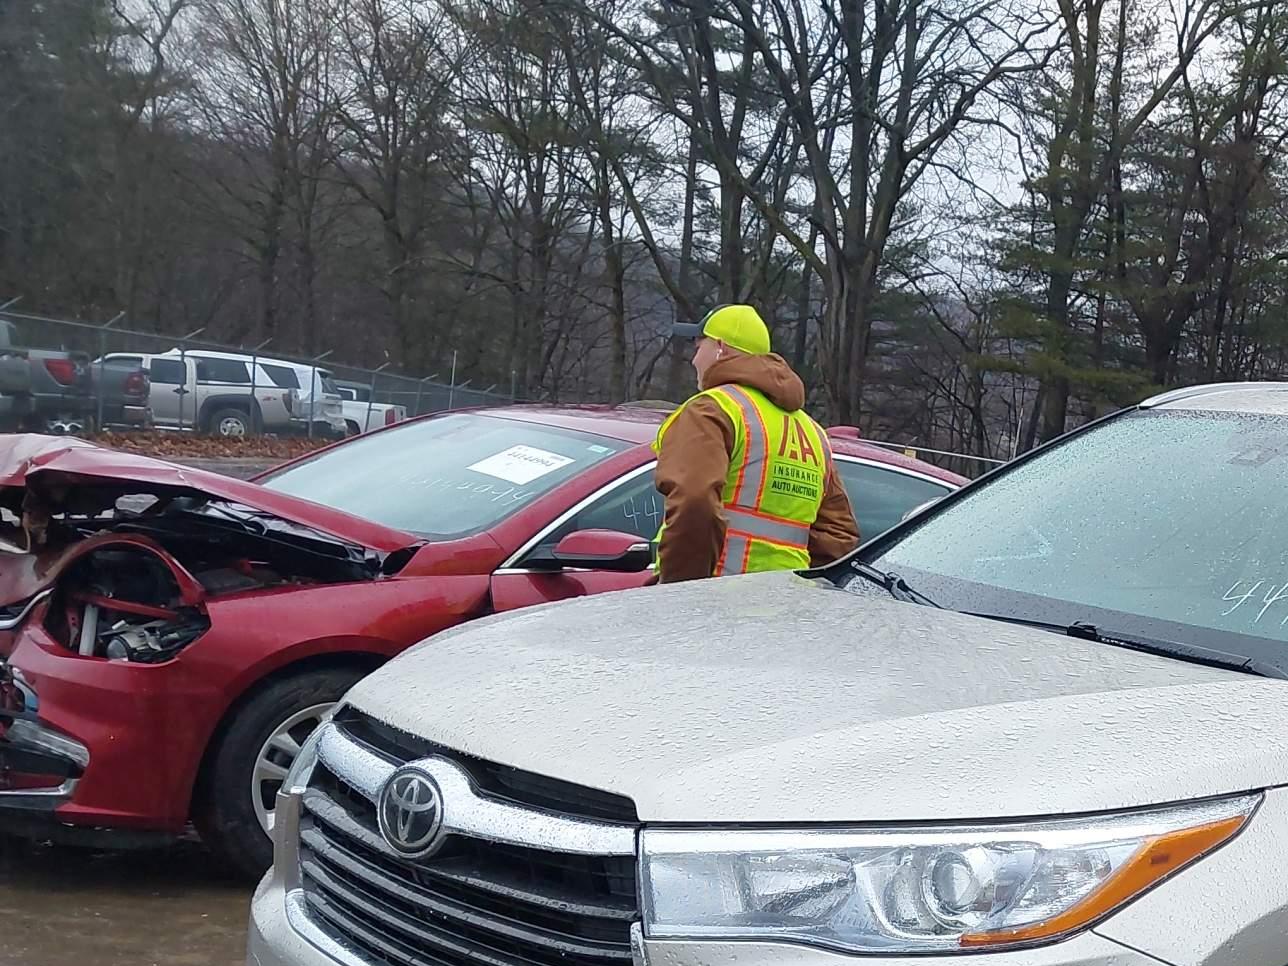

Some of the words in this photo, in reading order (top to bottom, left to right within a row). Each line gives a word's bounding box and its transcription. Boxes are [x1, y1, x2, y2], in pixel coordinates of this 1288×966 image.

[778, 415, 819, 467] IAA
[773, 465, 819, 483] INSURANCE
[771, 480, 791, 492] AUTO
[791, 483, 818, 499] AUCTIONS
